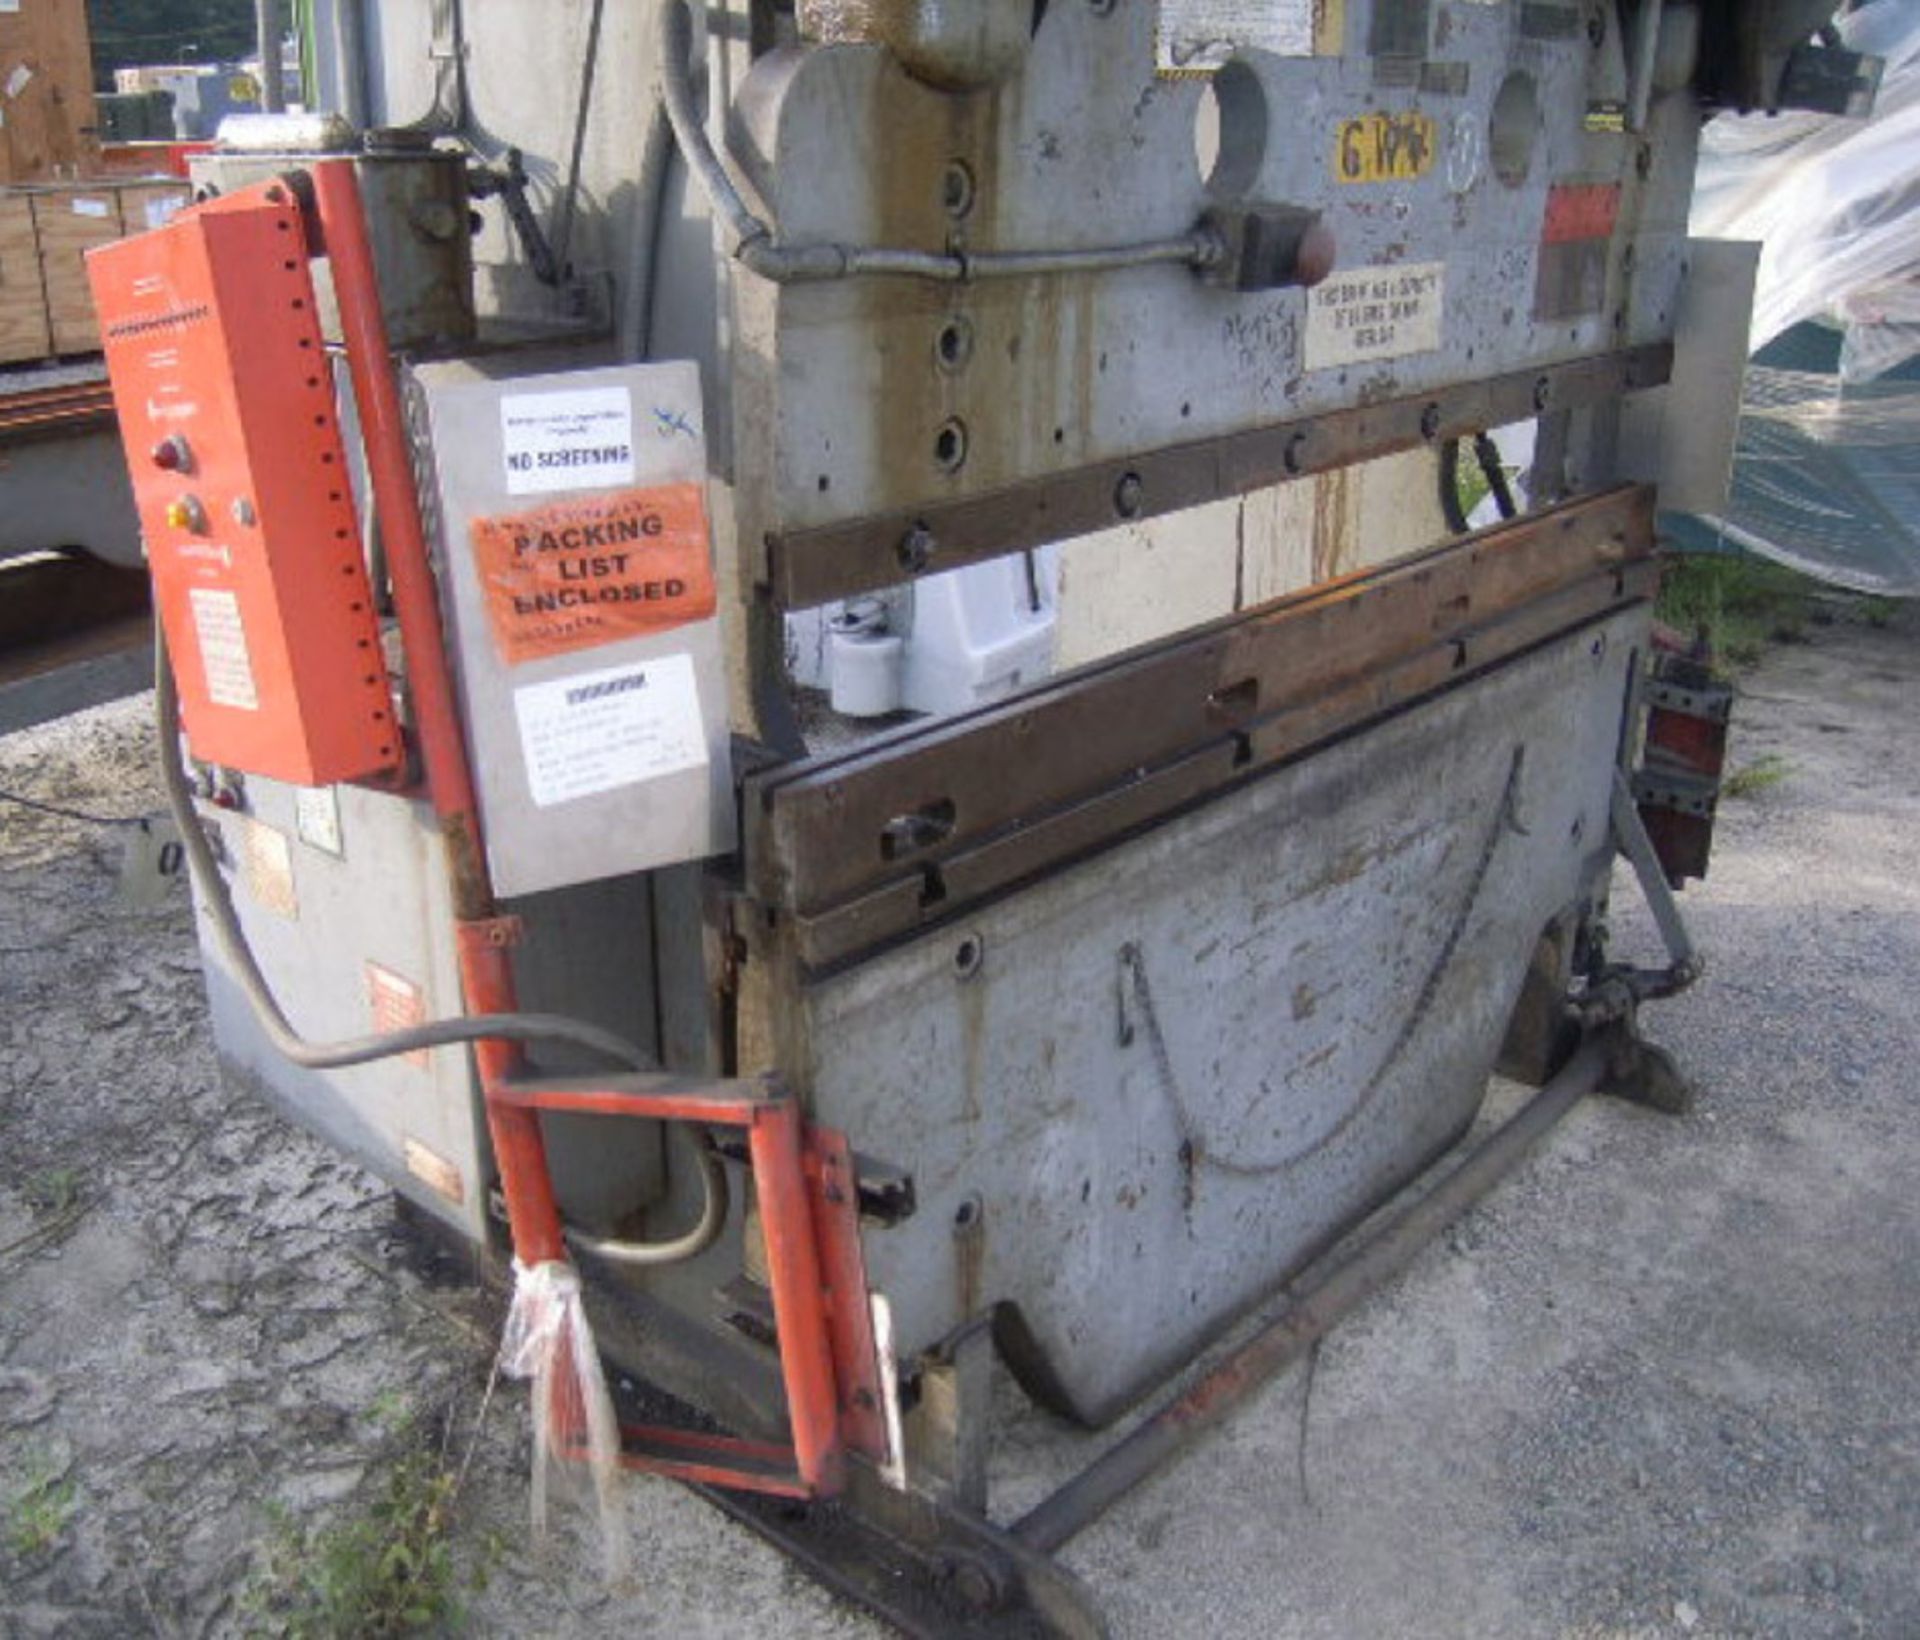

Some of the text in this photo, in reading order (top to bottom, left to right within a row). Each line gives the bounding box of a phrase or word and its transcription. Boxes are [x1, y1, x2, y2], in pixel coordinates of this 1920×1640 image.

[507, 444, 629, 471] NO SCREENING
[513, 514, 663, 556] PACKING
[559, 554, 629, 580] LIST
[511, 579, 686, 615] ENCLOSED
